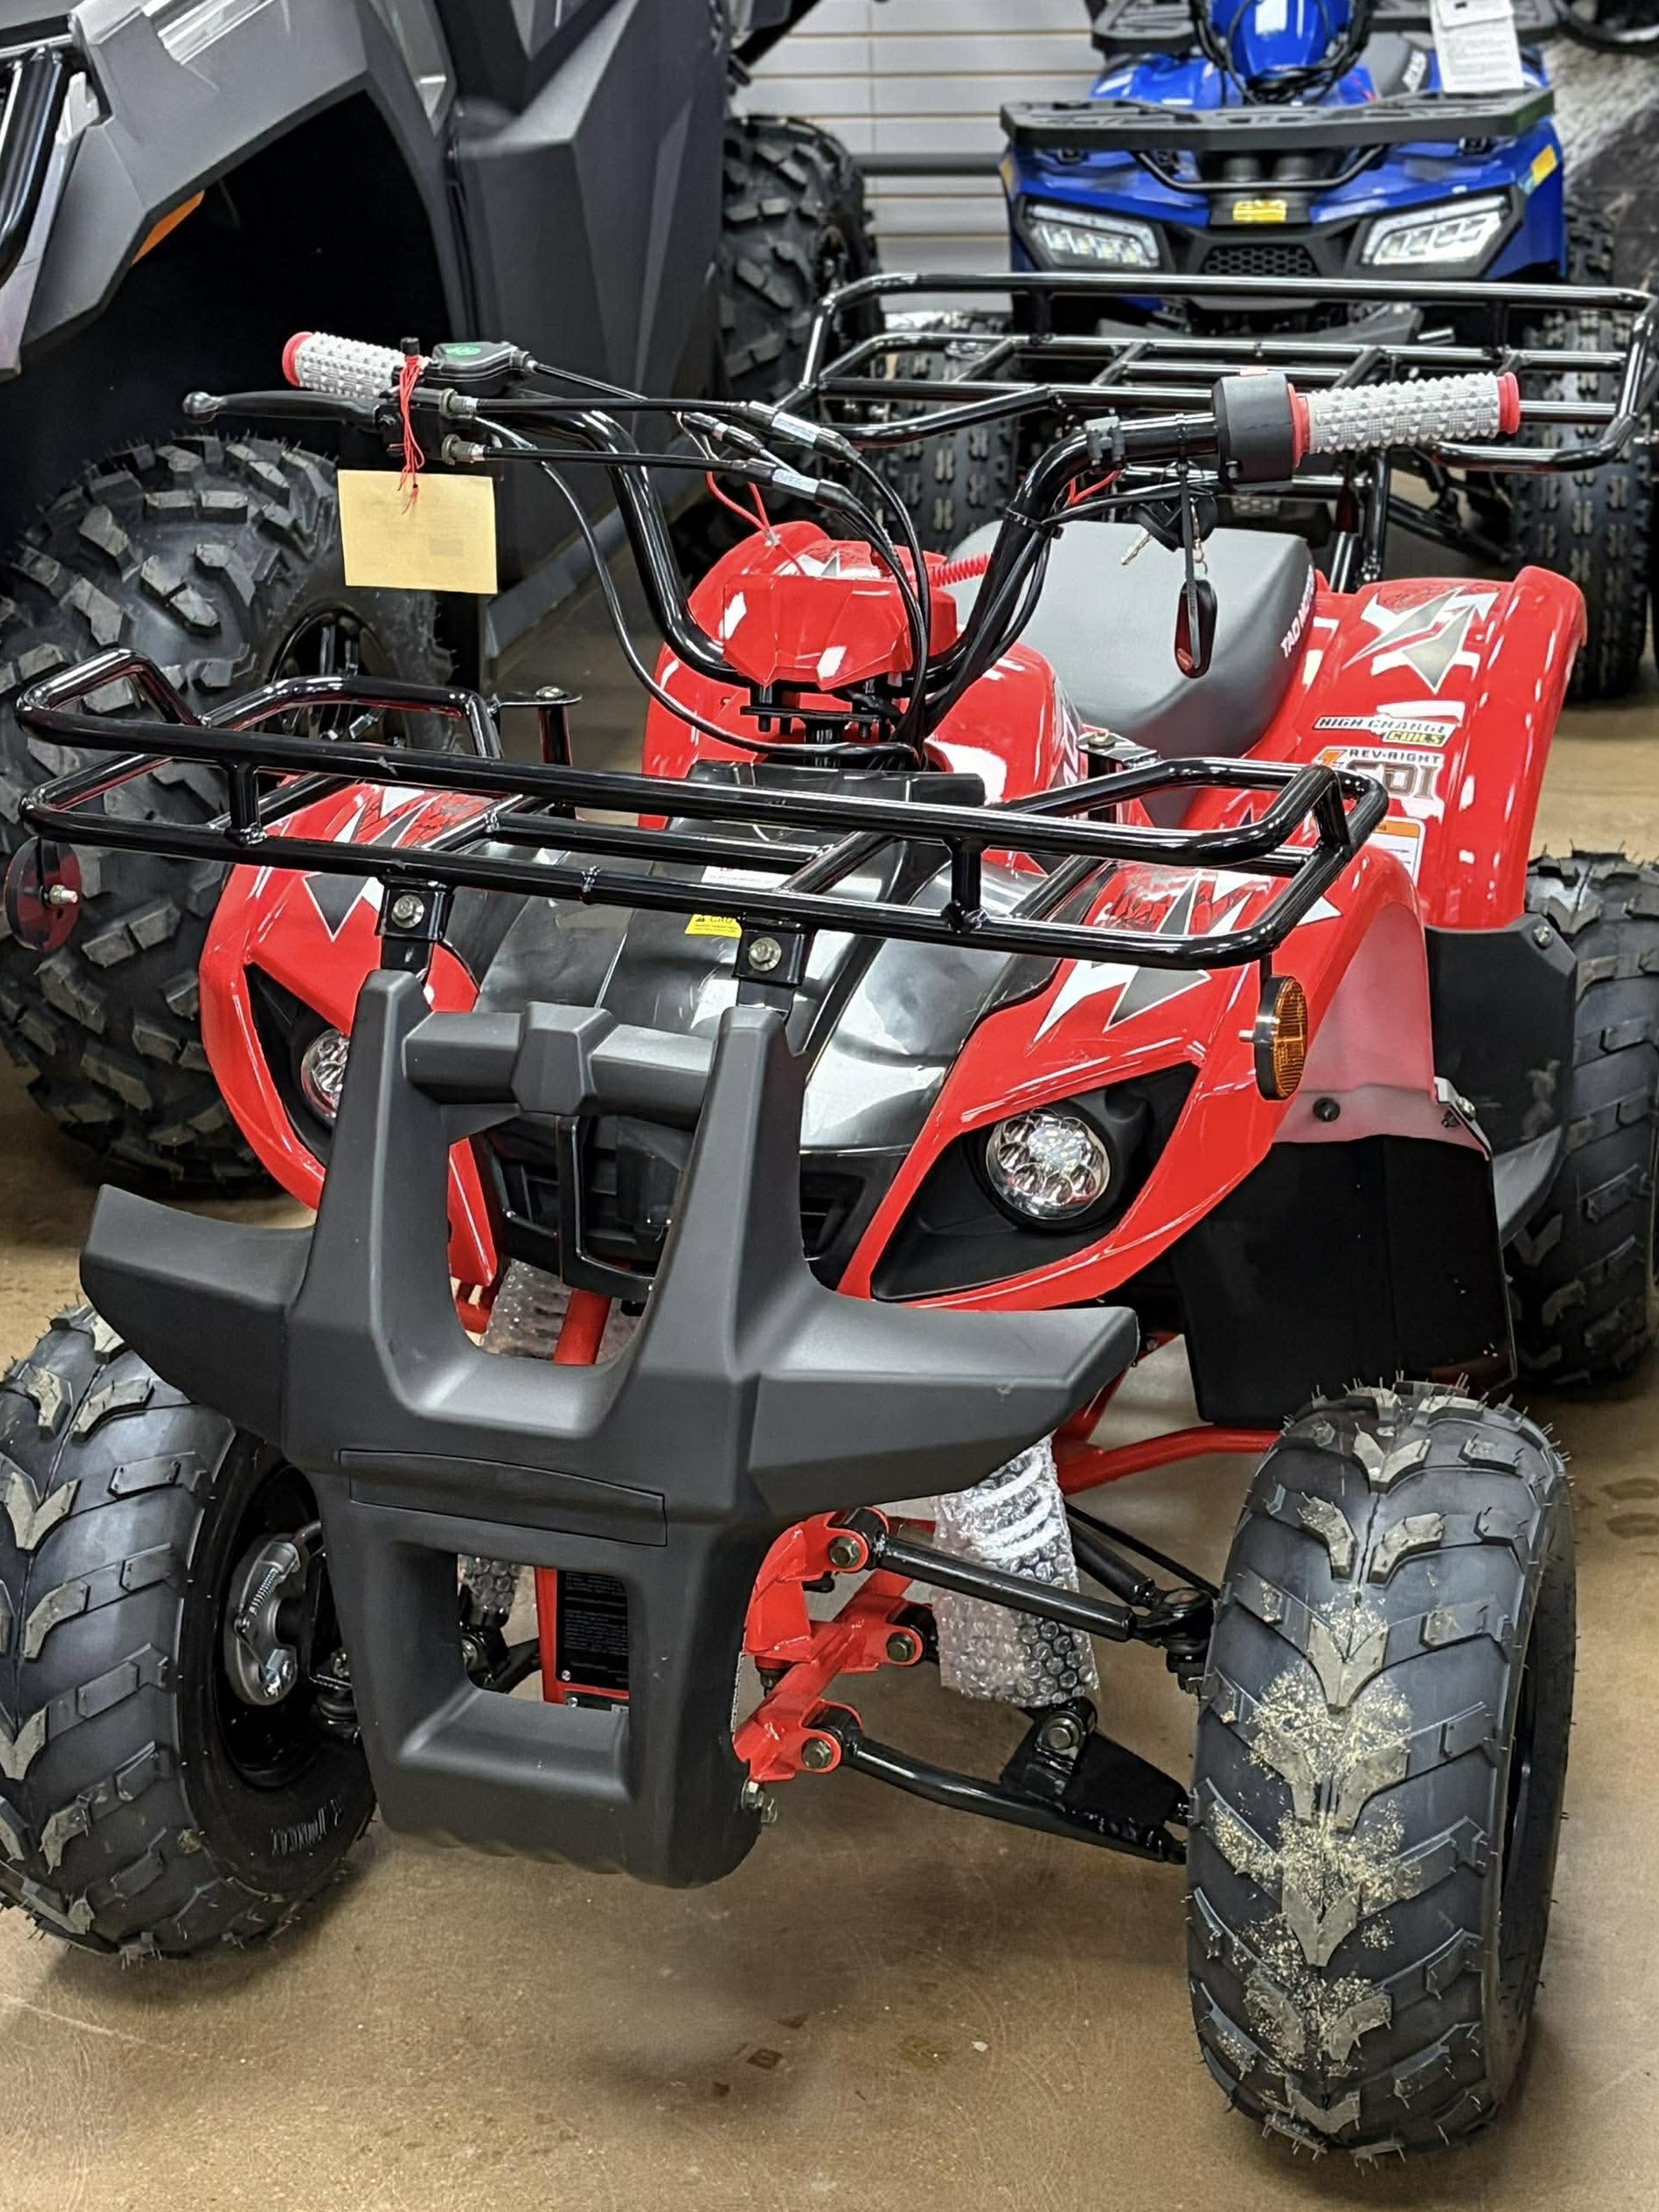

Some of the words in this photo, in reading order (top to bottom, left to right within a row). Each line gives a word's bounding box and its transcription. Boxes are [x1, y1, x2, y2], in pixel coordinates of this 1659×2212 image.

[1280, 616, 1301, 658] TAO
[1319, 718, 1364, 727] HIGH
[1367, 719, 1445, 733] CHARGE
[1387, 731, 1444, 744] COILS
